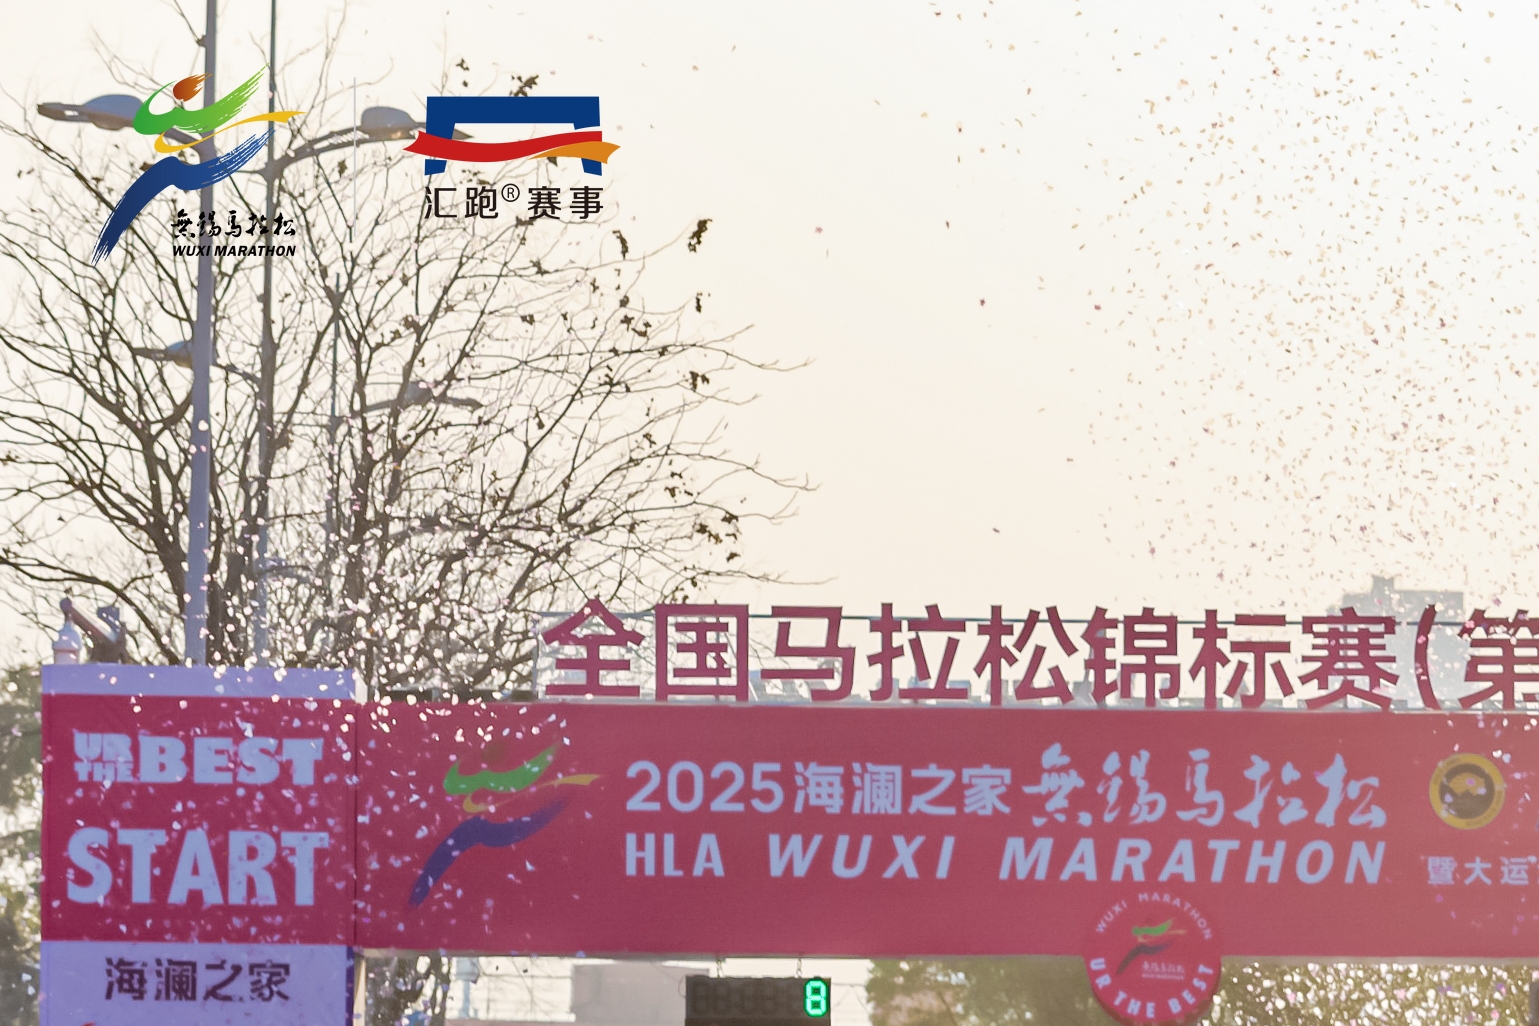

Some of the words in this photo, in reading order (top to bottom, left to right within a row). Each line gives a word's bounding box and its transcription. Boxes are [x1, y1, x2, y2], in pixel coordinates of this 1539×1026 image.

[74, 733, 131, 761] UR
[139, 735, 323, 785] BEST
[75, 761, 132, 782] THE
[67, 828, 329, 906] START
[625, 833, 726, 877] HLA
[768, 833, 955, 879] WUXI
[999, 837, 1386, 884] MARATHON
[1096, 900, 1128, 933] WUXI
[1138, 892, 1212, 940] MARATHON
[105, 957, 291, 1001] 海澜之家
[805, 979, 828, 1017] 8
[1089, 957, 1112, 990] UR
[1114, 990, 1156, 1019] THE
[1168, 964, 1213, 1014] BEST
